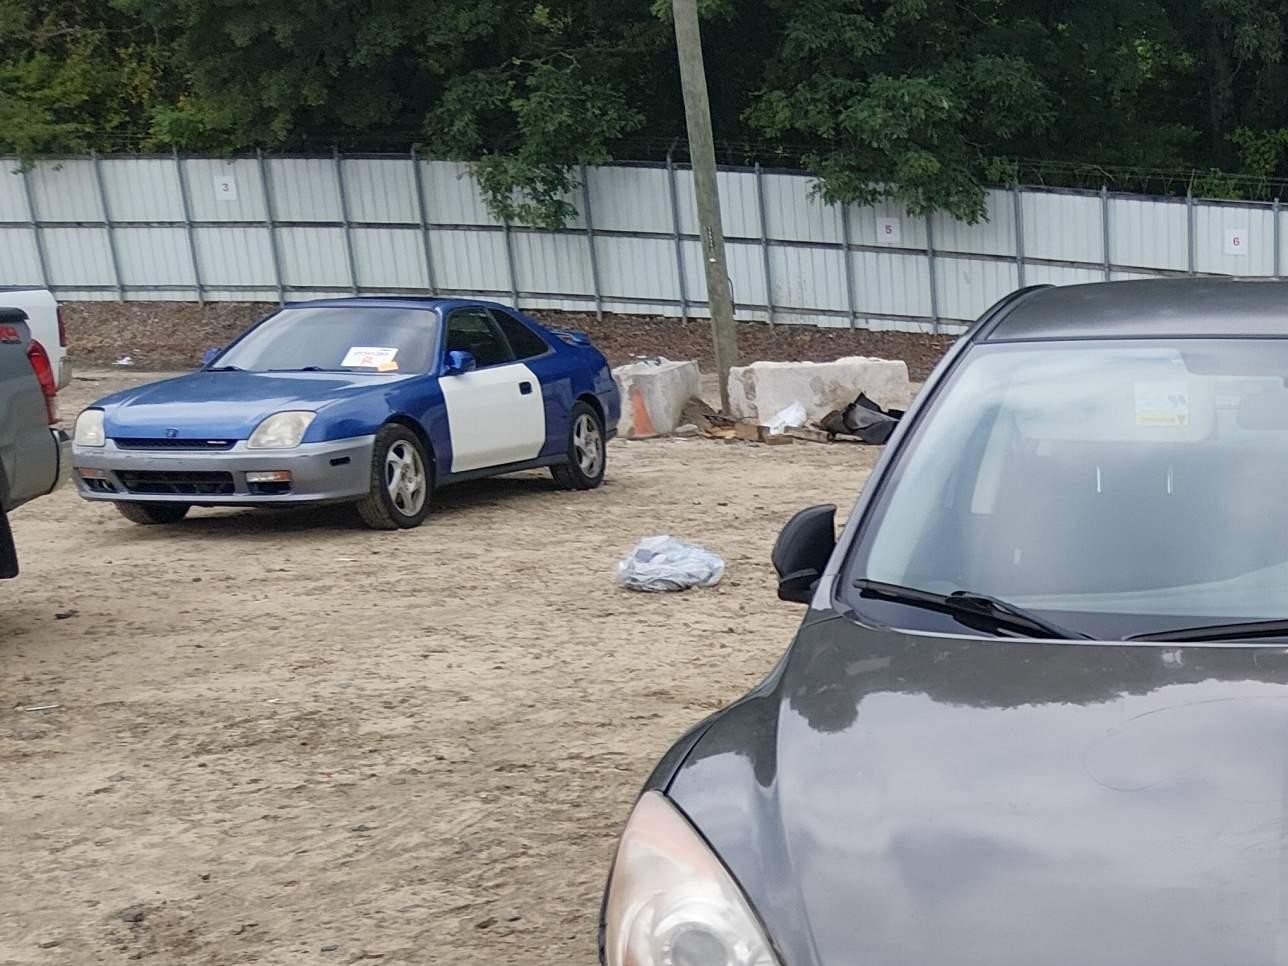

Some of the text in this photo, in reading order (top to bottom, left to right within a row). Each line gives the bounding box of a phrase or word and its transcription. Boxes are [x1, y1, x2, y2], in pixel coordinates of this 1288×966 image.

[221, 183, 229, 192] 3
[884, 224, 892, 234] 5
[1232, 237, 1240, 247] 6
